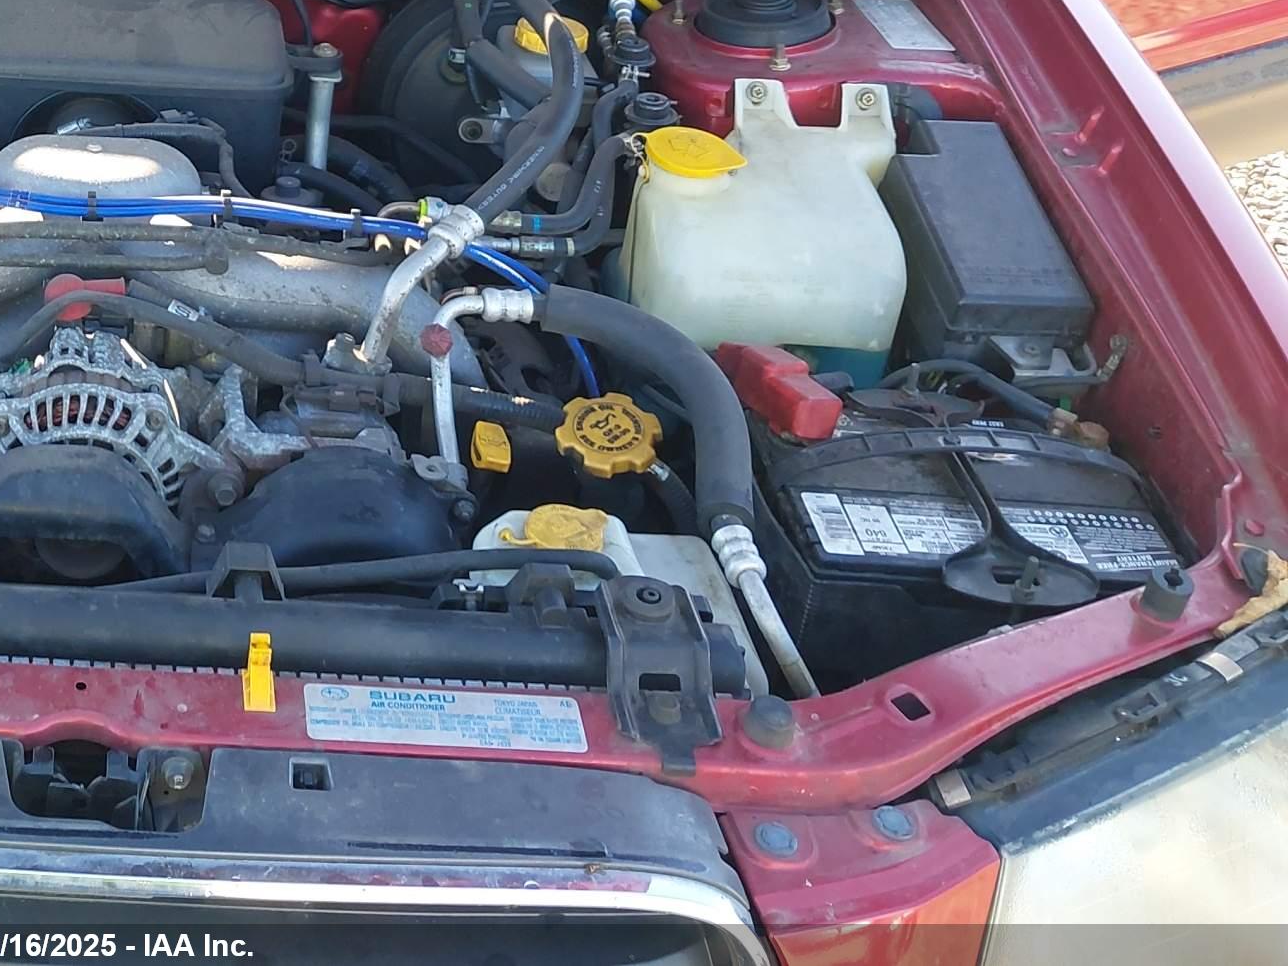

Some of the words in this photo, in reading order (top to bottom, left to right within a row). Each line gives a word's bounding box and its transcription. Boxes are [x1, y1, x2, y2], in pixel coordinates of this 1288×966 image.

[1116, 554, 1153, 563] BATTERY
[369, 690, 456, 703] SUBARU
[387, 702, 445, 711] CONDITIONER
